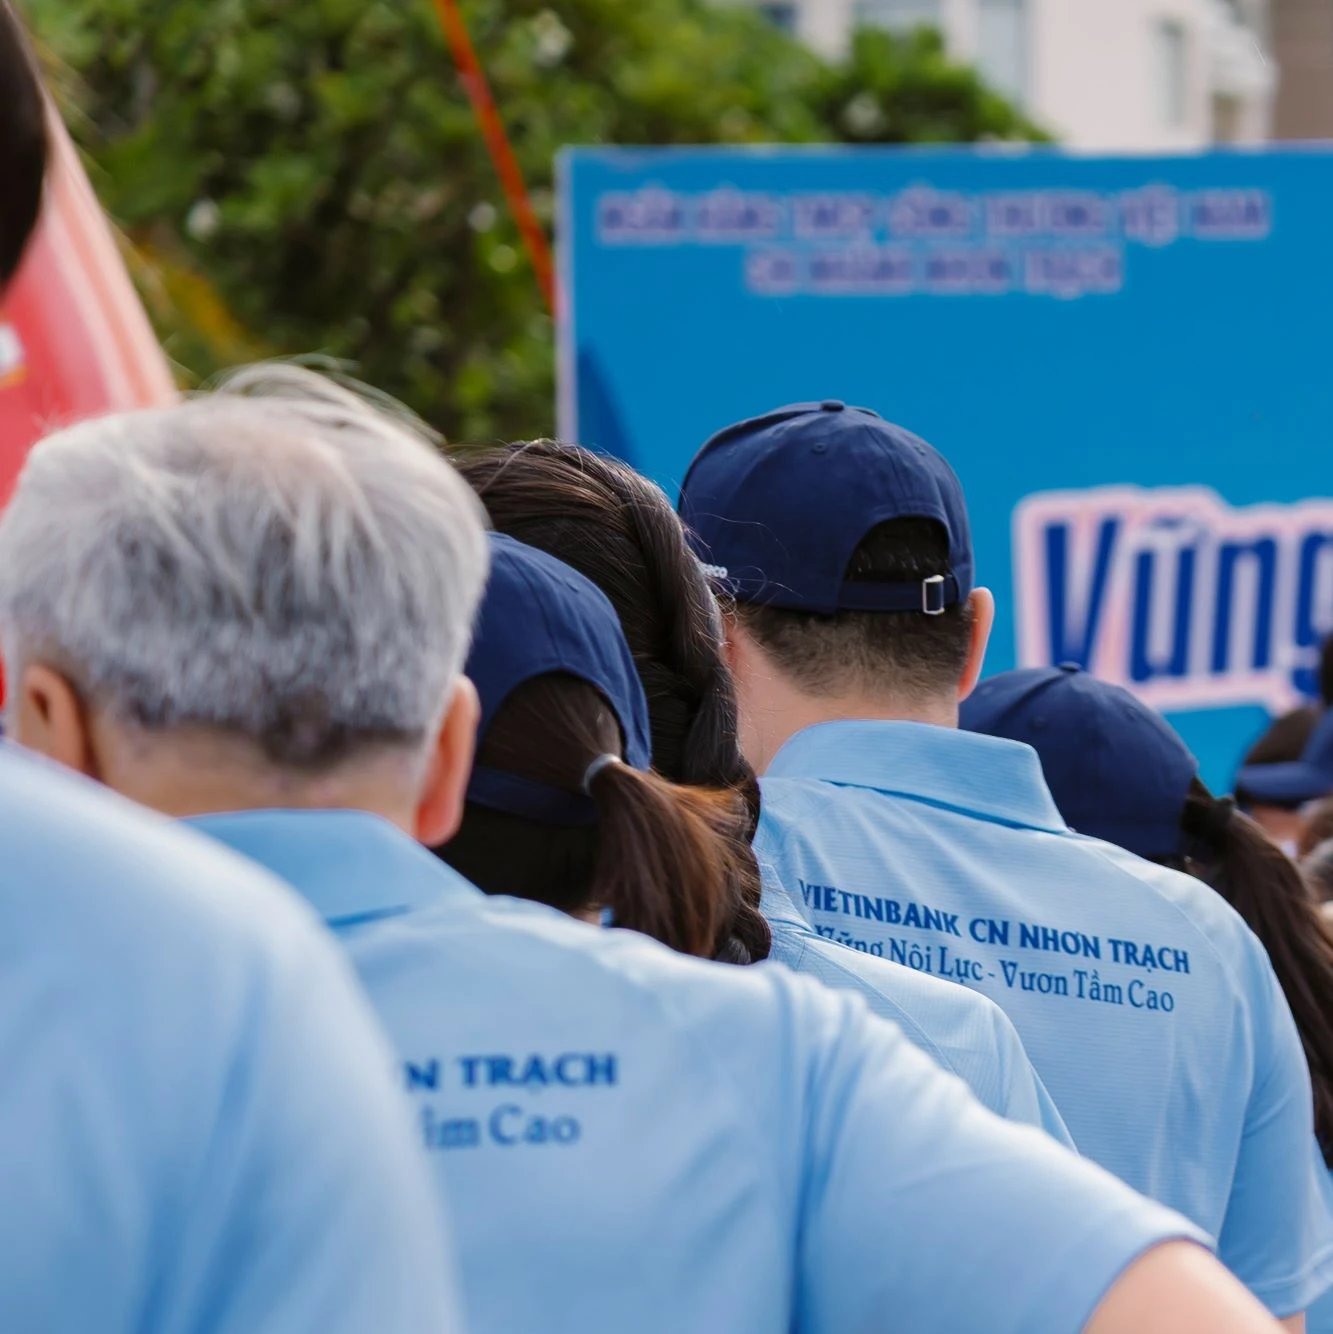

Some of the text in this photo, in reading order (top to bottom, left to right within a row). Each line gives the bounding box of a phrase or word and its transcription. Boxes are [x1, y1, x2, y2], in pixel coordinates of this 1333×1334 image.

[798, 879, 1191, 975] VIETINBANK CN NHƠN TRẠCH
[939, 945, 984, 983] Lực
[999, 958, 1069, 997] Vươn
[1073, 968, 1124, 1006] Tầm
[1127, 978, 1175, 1013] Cao
[487, 1102, 584, 1148] Cao
